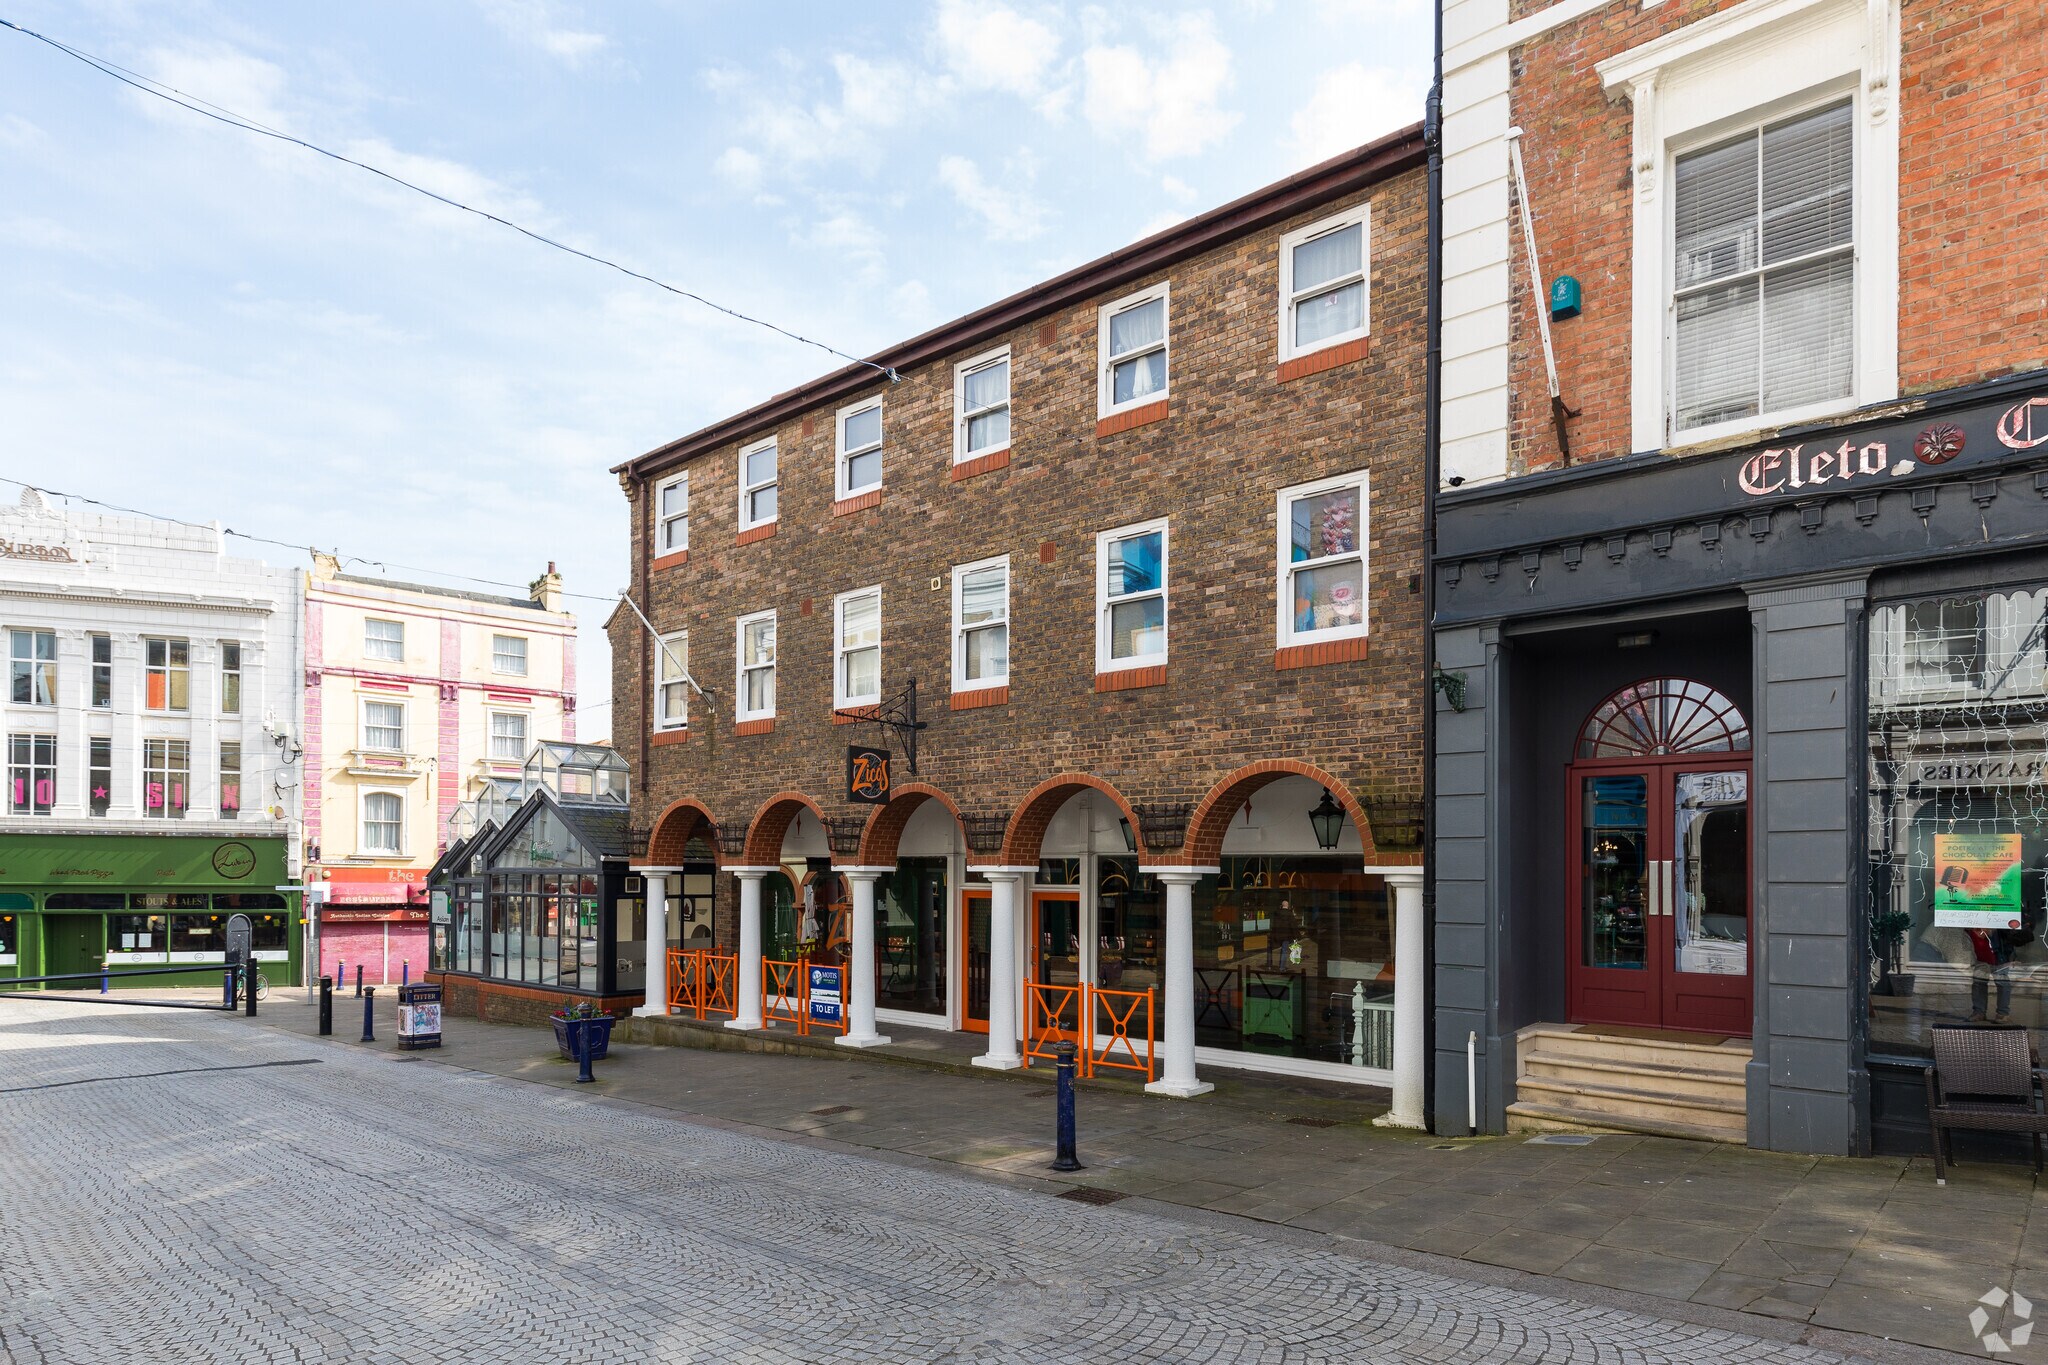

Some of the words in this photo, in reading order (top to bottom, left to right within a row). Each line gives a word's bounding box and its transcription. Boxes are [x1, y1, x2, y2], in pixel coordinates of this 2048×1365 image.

[1738, 439, 1887, 496] Eleto
[14, 778, 54, 805] 10
[388, 869, 415, 882] the
[136, 898, 169, 906] STOUTS
[171, 898, 178, 906] &
[181, 898, 203, 906] ALES
[409, 911, 424, 919] The
[437, 915, 450, 923] Asian
[815, 1004, 824, 1013] TO
[824, 1005, 835, 1014] LET
